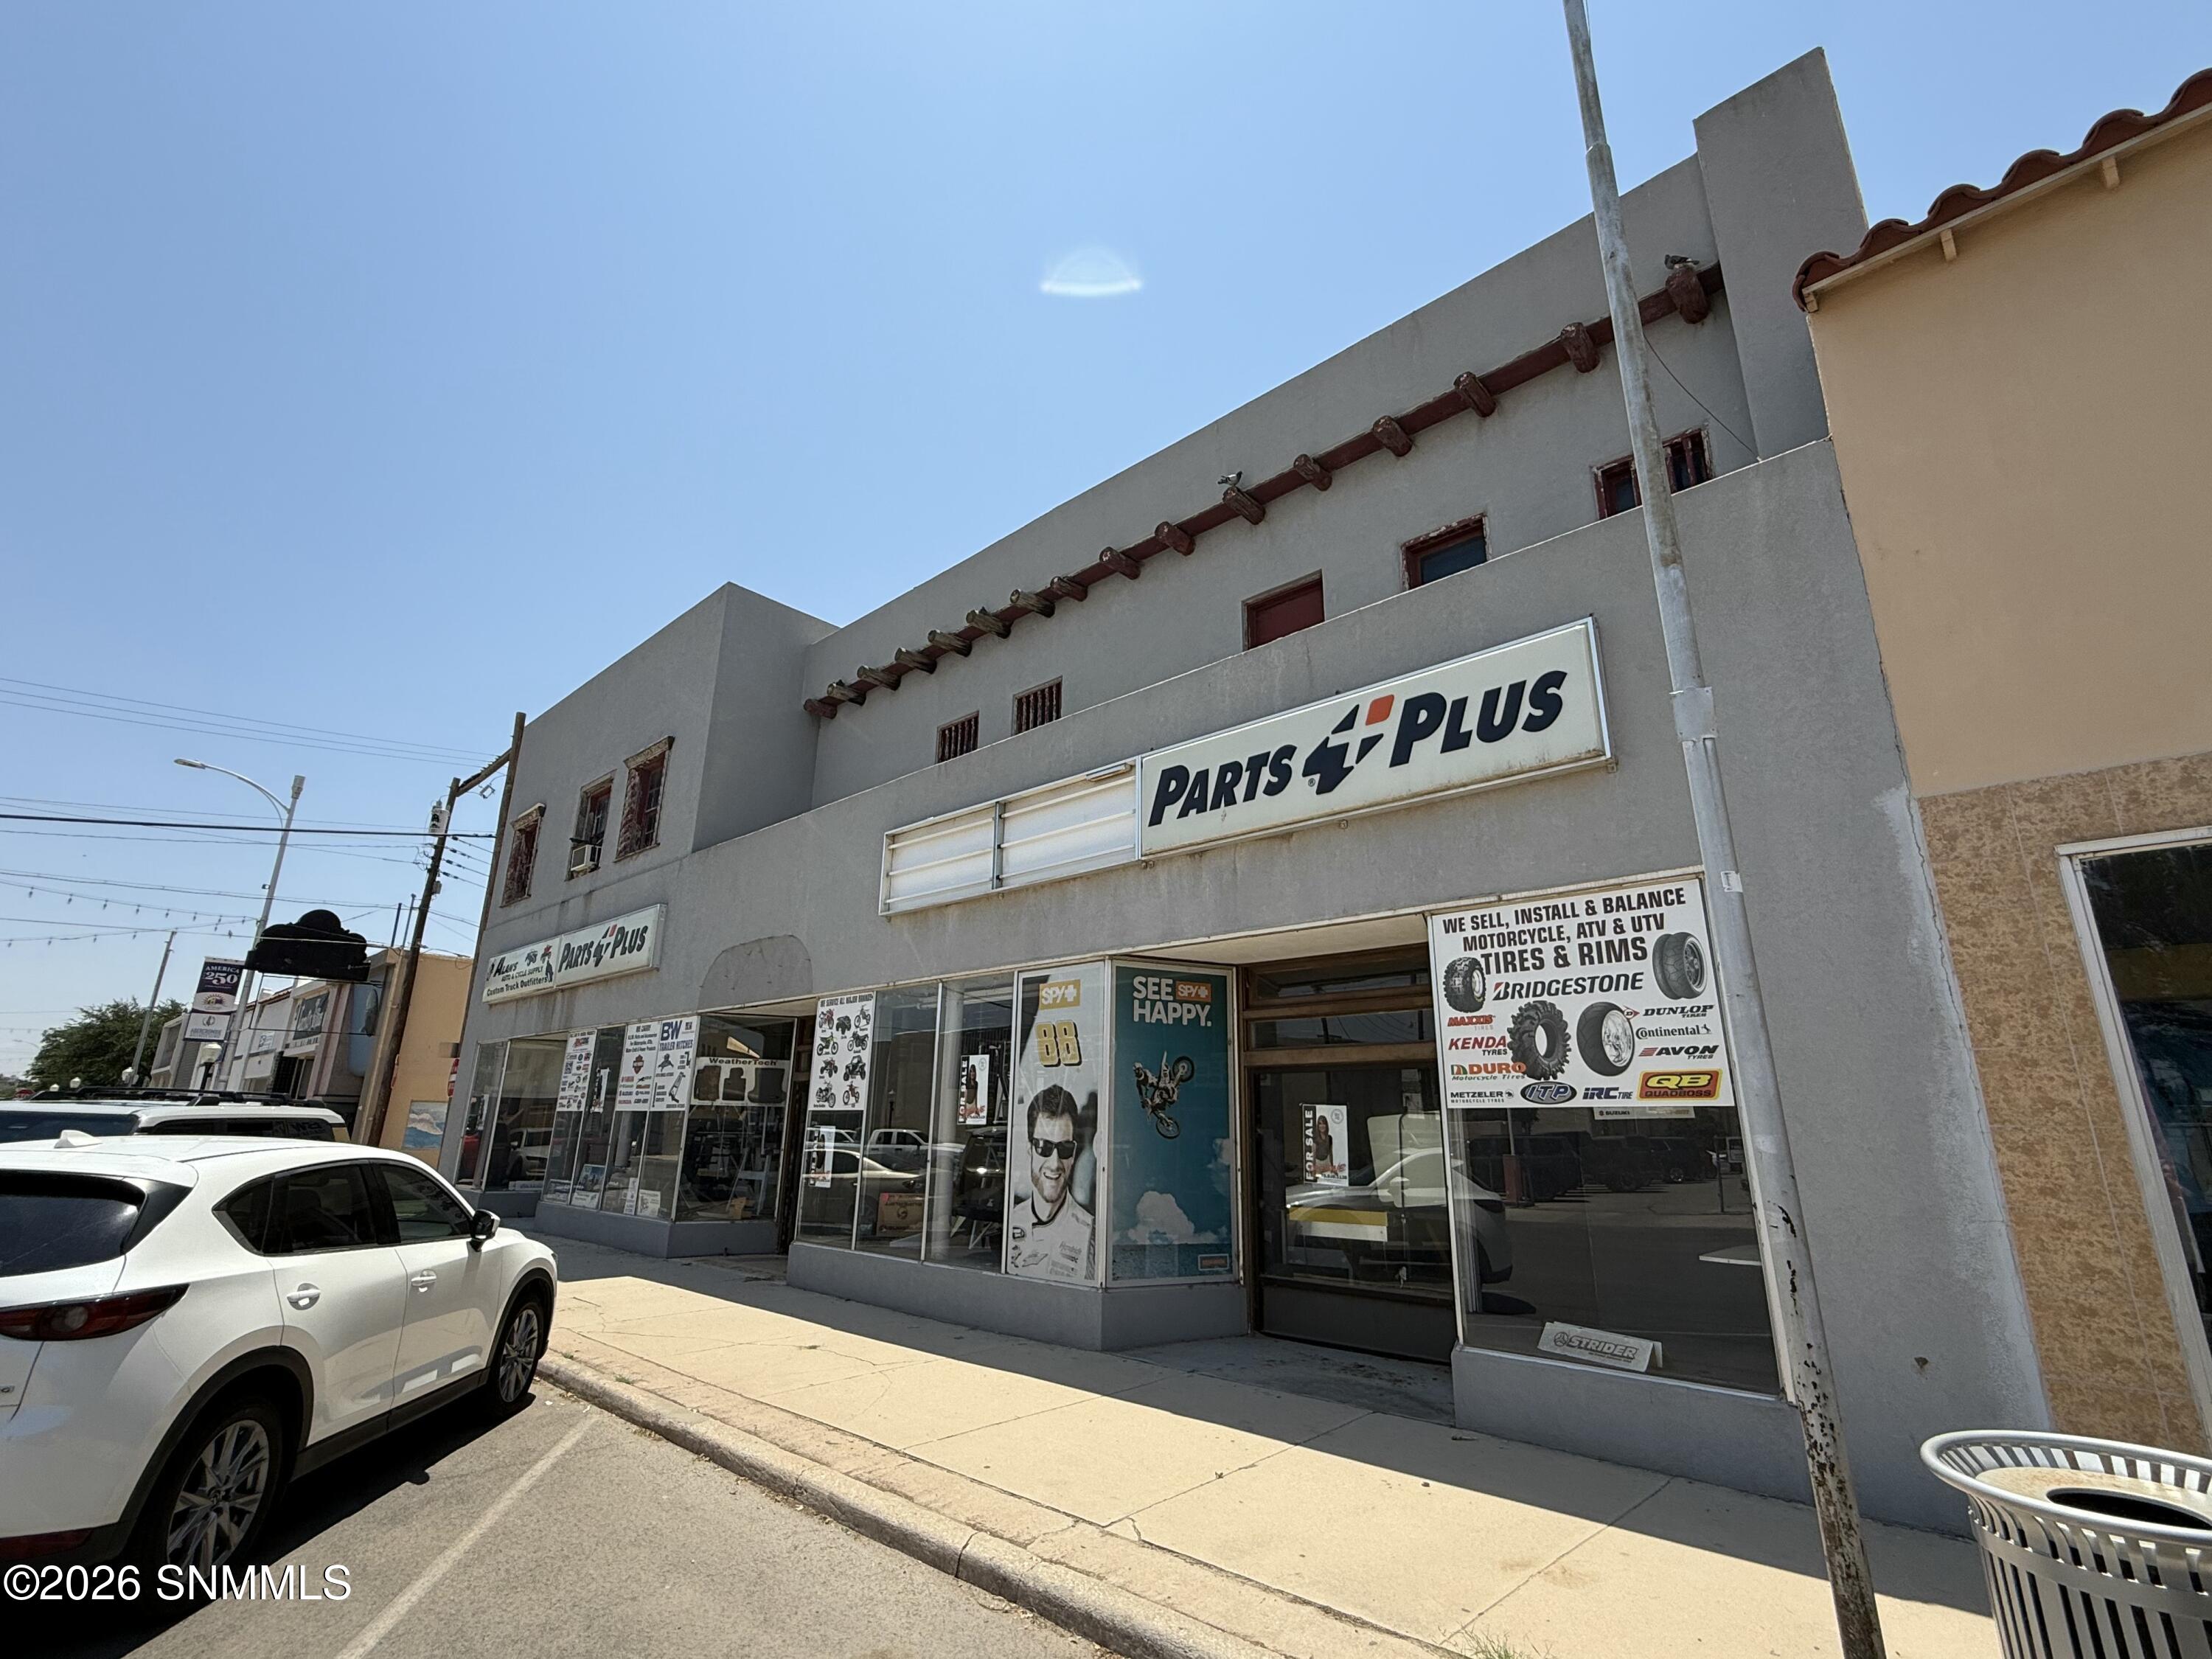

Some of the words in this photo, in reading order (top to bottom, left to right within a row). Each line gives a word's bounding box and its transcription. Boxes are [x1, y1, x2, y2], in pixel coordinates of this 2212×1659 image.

[1148, 744, 1297, 827] PARTS
[1389, 670, 1568, 768] PLUS
[1443, 917, 1466, 933] WE
[1470, 912, 1509, 930] SELL,
[1514, 902, 1579, 925] INSTALL
[1585, 900, 1597, 916] &
[1602, 887, 1686, 914] BALANCE
[1463, 925, 1571, 952] MOTORCYCLE,
[1576, 919, 1606, 939] ATV
[1613, 918, 1626, 935] &
[1631, 913, 1664, 933] UTV
[558, 941, 594, 973] PARTS
[610, 925, 648, 959] PLUS
[1481, 947, 1545, 975] TIRES
[1554, 945, 1571, 968] &
[1578, 936, 1648, 966] RIMS
[204, 971, 238, 985] 250
[527, 966, 543, 975] SUPPLY
[487, 987, 504, 996] Custom
[505, 982, 518, 991] Truck
[520, 975, 548, 988] Outfitters
[1133, 975, 1173, 1001] SEE
[1492, 972, 1644, 1001] BRIDGESTONE
[1133, 999, 1211, 1026] HAPPY.
[1643, 1005, 1714, 1016] DUNLOP
[1447, 1015, 1494, 1026] MAXXIS
[1635, 1024, 1700, 1040] Continental
[1035, 1020, 1082, 1067] 88
[1448, 1035, 1507, 1050] KENDA
[1655, 1045, 1719, 1056] AVON
[709, 1057, 777, 1065] WeatherTech
[1468, 1062, 1526, 1075] DURO
[1646, 1074, 1712, 1090] QB
[1526, 1084, 1571, 1102] ITP
[1618, 1091, 1633, 1099] TIRE
[1306, 1152, 1314, 1180] FOR
[1567, 1335, 1638, 1360] STRIDER
